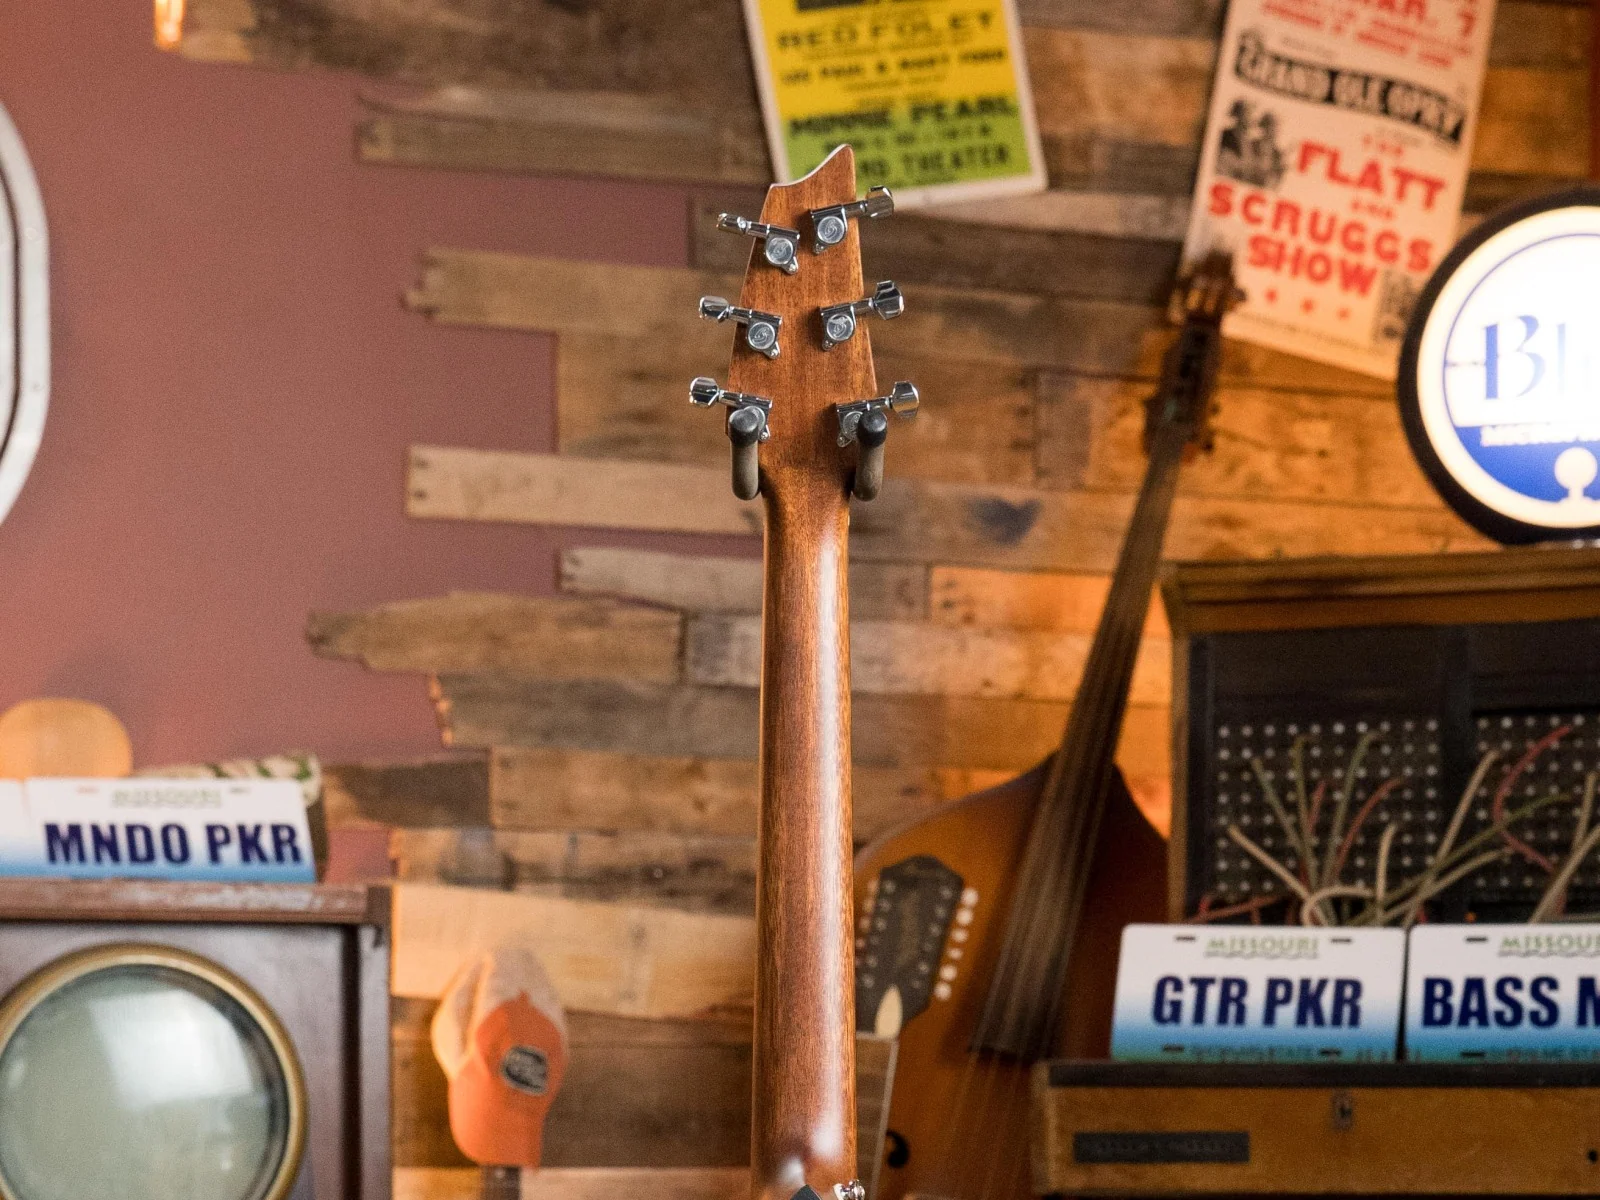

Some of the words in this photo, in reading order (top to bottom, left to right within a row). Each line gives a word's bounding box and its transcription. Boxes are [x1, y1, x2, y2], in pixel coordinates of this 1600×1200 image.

[1297, 140, 1446, 212] FLATT
[1208, 181, 1435, 275] SCRUGGS
[1246, 234, 1381, 299] SHOW
[43, 822, 191, 866] MNDO
[205, 822, 304, 866] PKR
[1205, 935, 1320, 955] MISSOURI
[1152, 974, 1249, 1028] GTR
[1263, 976, 1363, 1029] PKR
[1422, 976, 1560, 1029] BASS
